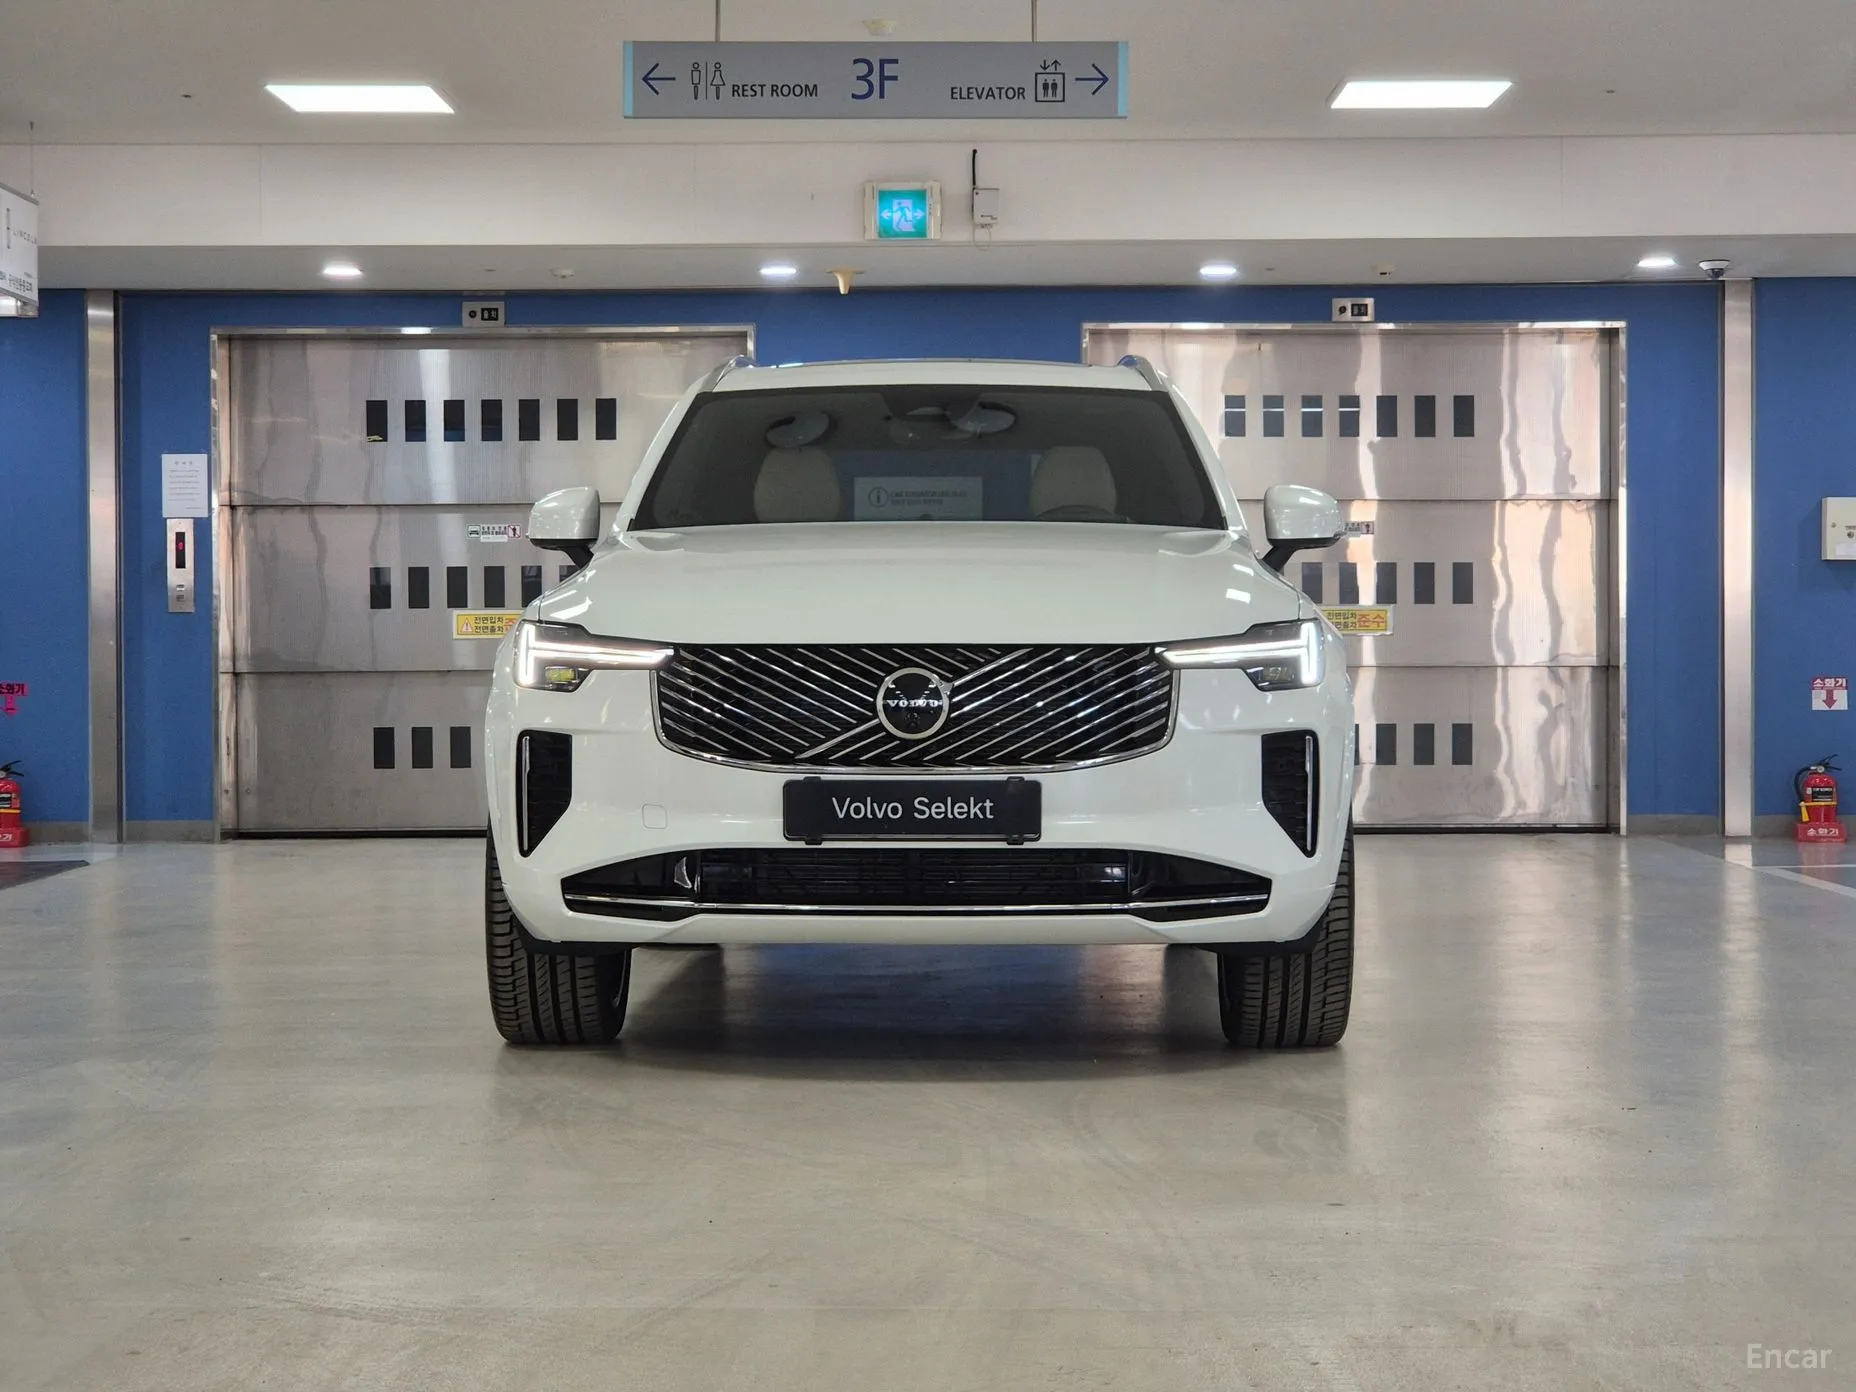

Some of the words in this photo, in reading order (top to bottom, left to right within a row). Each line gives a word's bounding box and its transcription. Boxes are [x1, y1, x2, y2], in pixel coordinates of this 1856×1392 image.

[851, 57, 899, 100] 3F
[731, 84, 766, 98] REST
[770, 84, 818, 98] ROOM
[950, 86, 1026, 100] ELEVATOR
[473, 616, 504, 625] 전면입차
[1357, 613, 1385, 629] 준수
[1812, 678, 1847, 688] 소화기
[831, 796, 903, 819] Volvo
[913, 796, 995, 819] Selekt
